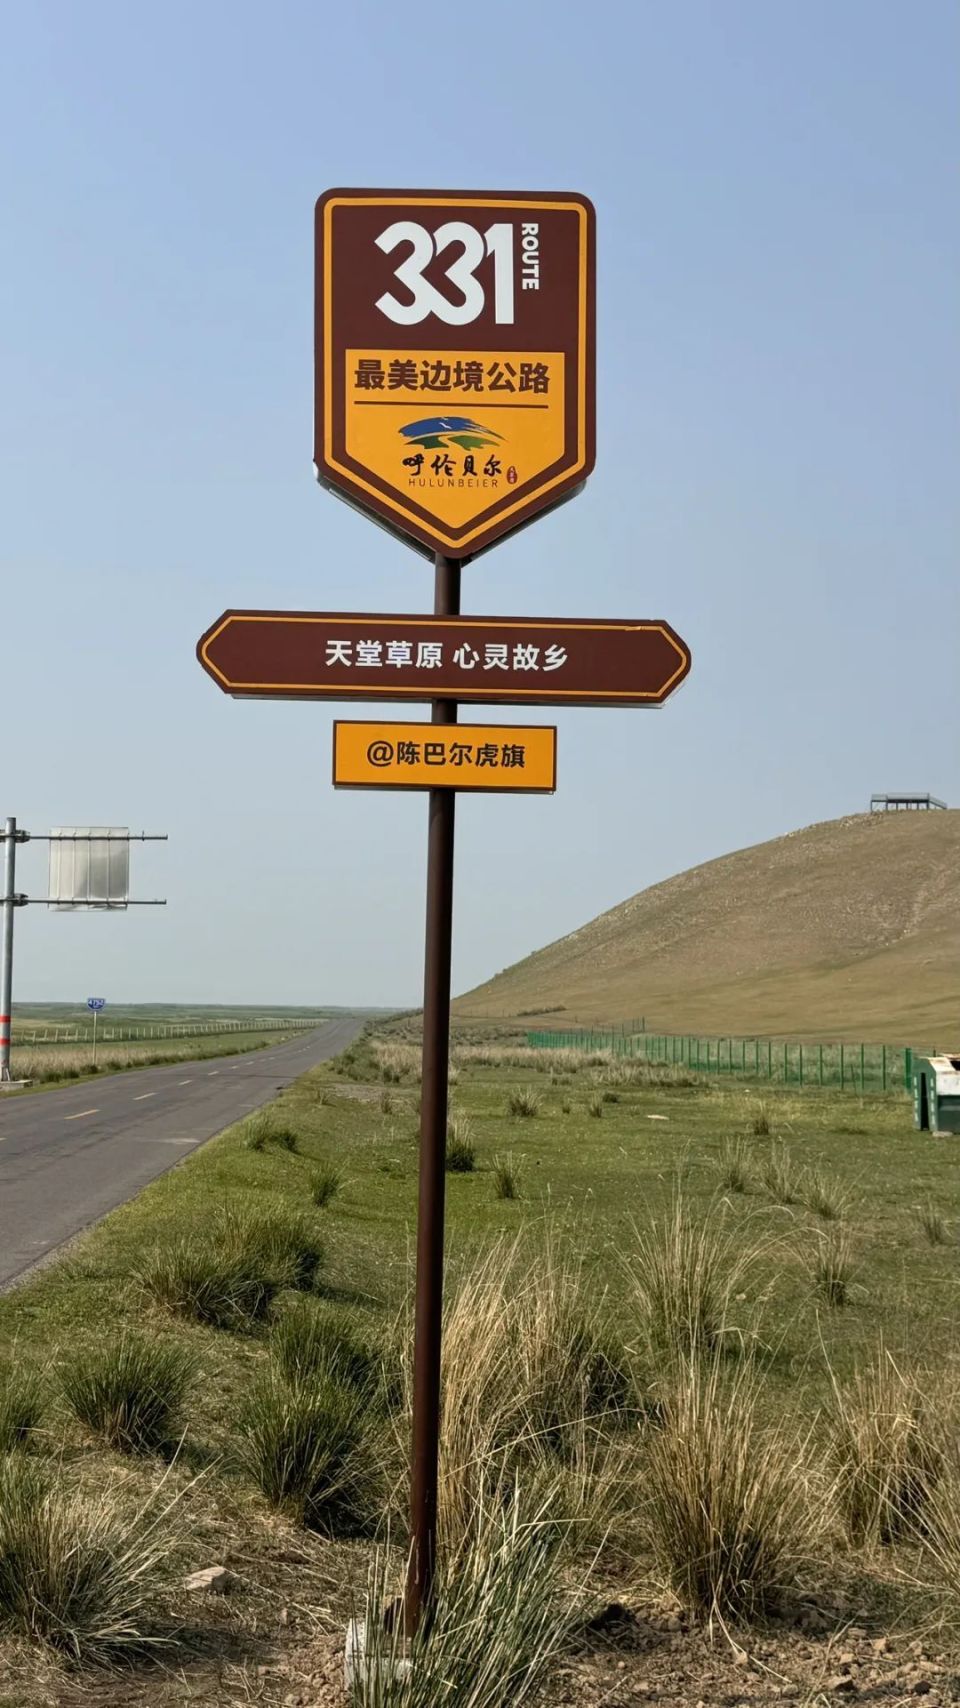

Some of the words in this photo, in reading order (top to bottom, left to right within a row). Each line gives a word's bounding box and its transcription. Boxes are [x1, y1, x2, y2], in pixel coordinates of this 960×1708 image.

[521, 223, 540, 290] ROUTE
[374, 220, 514, 325] 331
[355, 359, 550, 394] 最美边境公路
[402, 453, 502, 477] 呼伦贝尔
[408, 478, 498, 488] HULUNBEIER
[325, 640, 443, 669] 天堂草原
[452, 642, 568, 671] 心灵故乡
[366, 740, 526, 768] @陈巴尔虎旗
